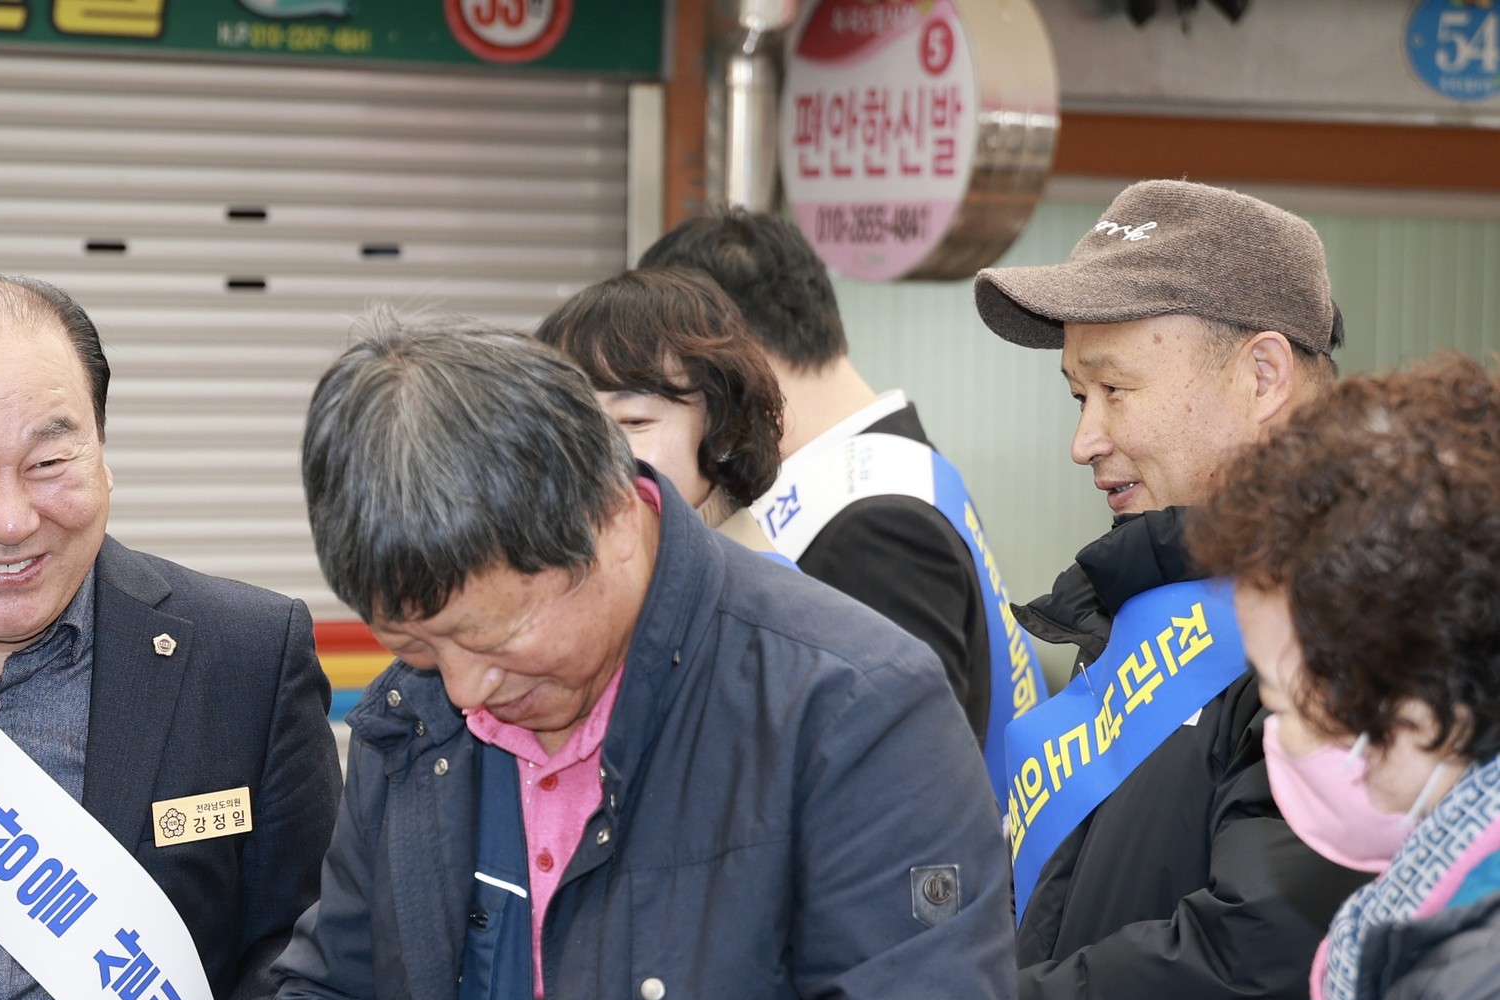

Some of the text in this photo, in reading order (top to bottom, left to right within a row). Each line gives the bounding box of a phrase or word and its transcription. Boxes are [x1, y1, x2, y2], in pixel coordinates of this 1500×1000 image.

[925, 28, 947, 70] 5
[1434, 11, 1499, 73] 54
[794, 84, 963, 178] 편안한신발
[757, 484, 803, 540] 전
[196, 797, 241, 813] 전라남도의원
